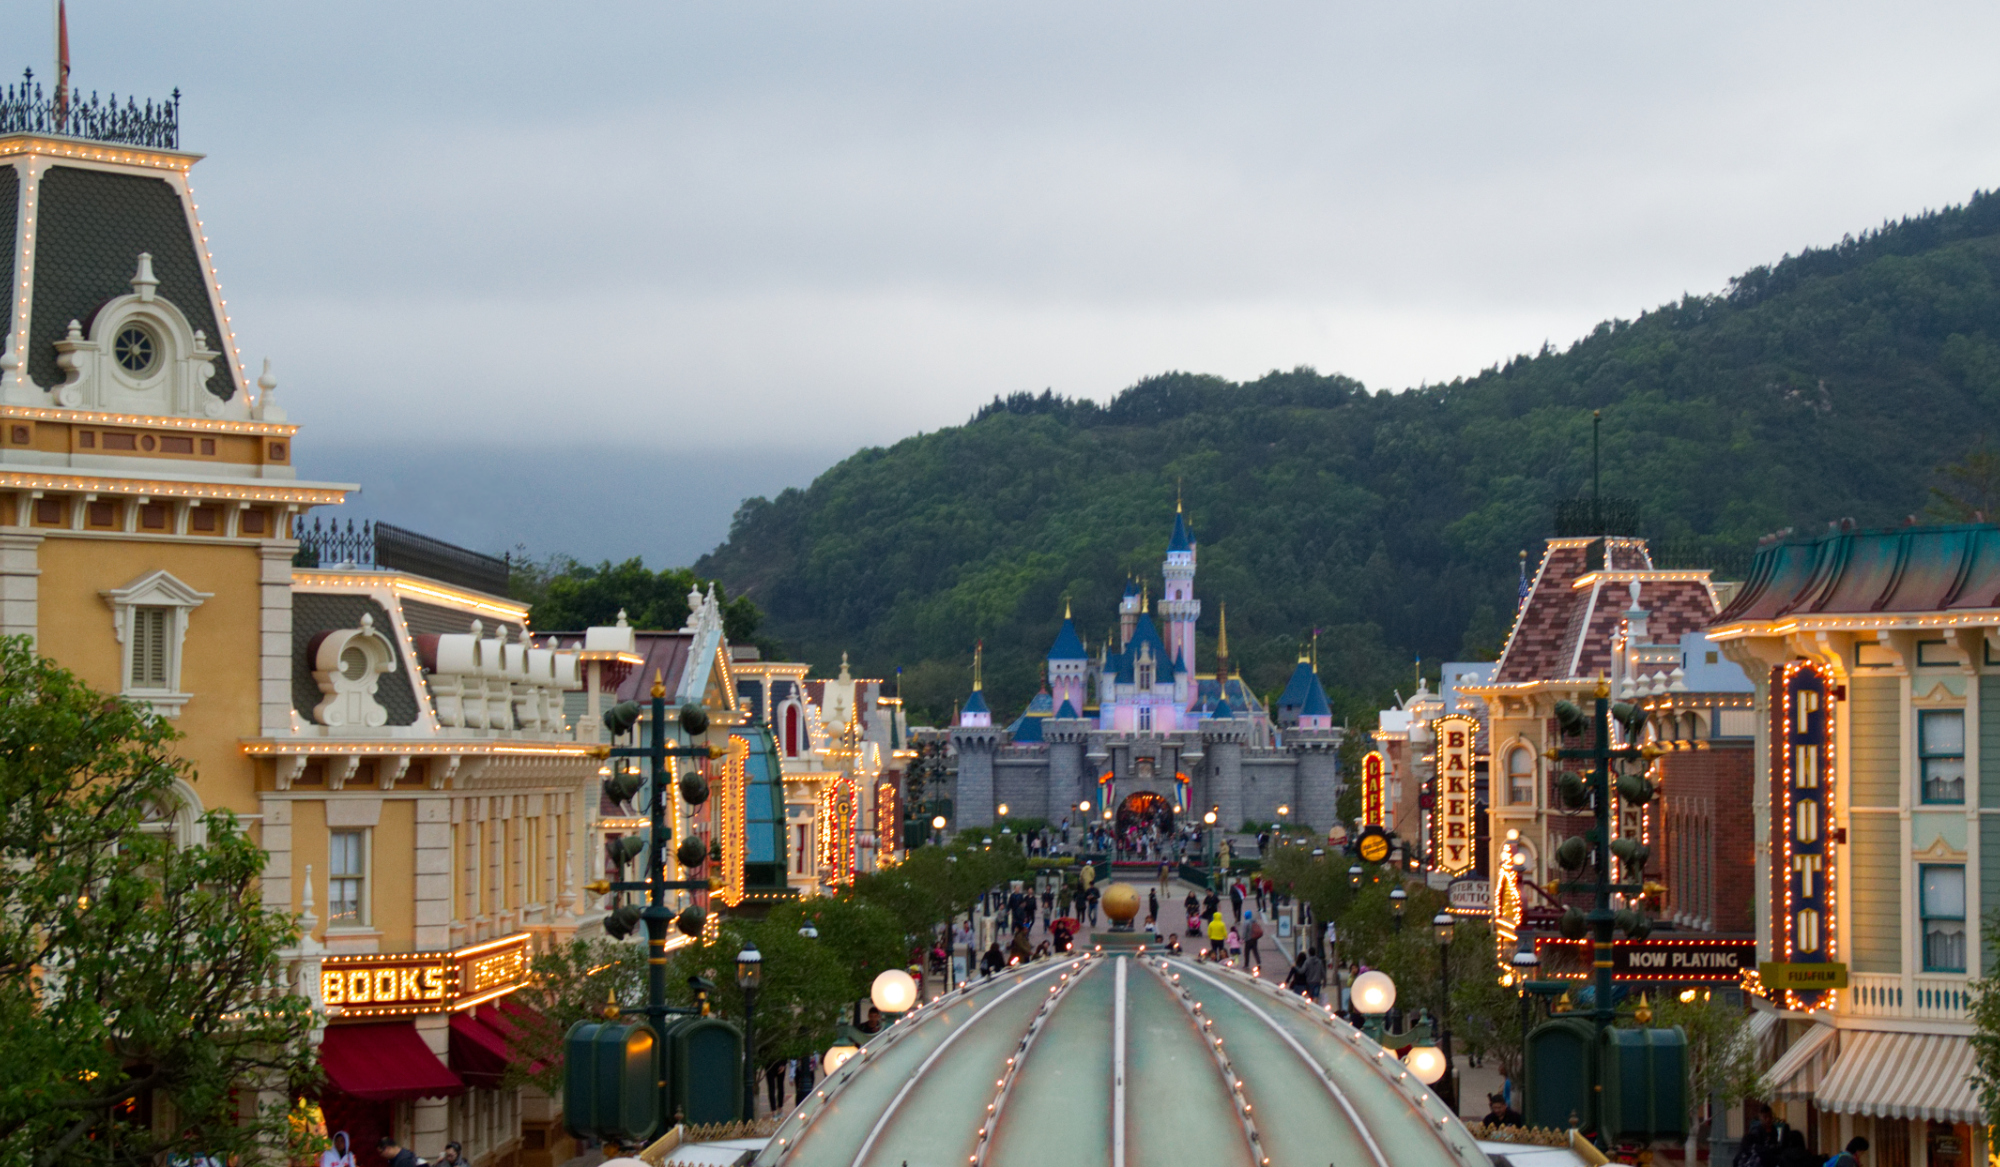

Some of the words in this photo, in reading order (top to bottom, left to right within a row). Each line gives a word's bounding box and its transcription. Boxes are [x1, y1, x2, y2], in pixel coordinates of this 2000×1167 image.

[729, 759, 737, 798] GOODS
[1369, 762, 1378, 824] CAFE
[1446, 731, 1468, 861] BAKERY
[729, 816, 737, 847] FINE
[1793, 690, 1822, 954] PHOTO
[1629, 952, 1668, 967] NOW
[1672, 952, 1738, 968] PLAYING
[1789, 971, 1836, 981] FUJIFILM
[321, 966, 443, 1004] BOOKS
